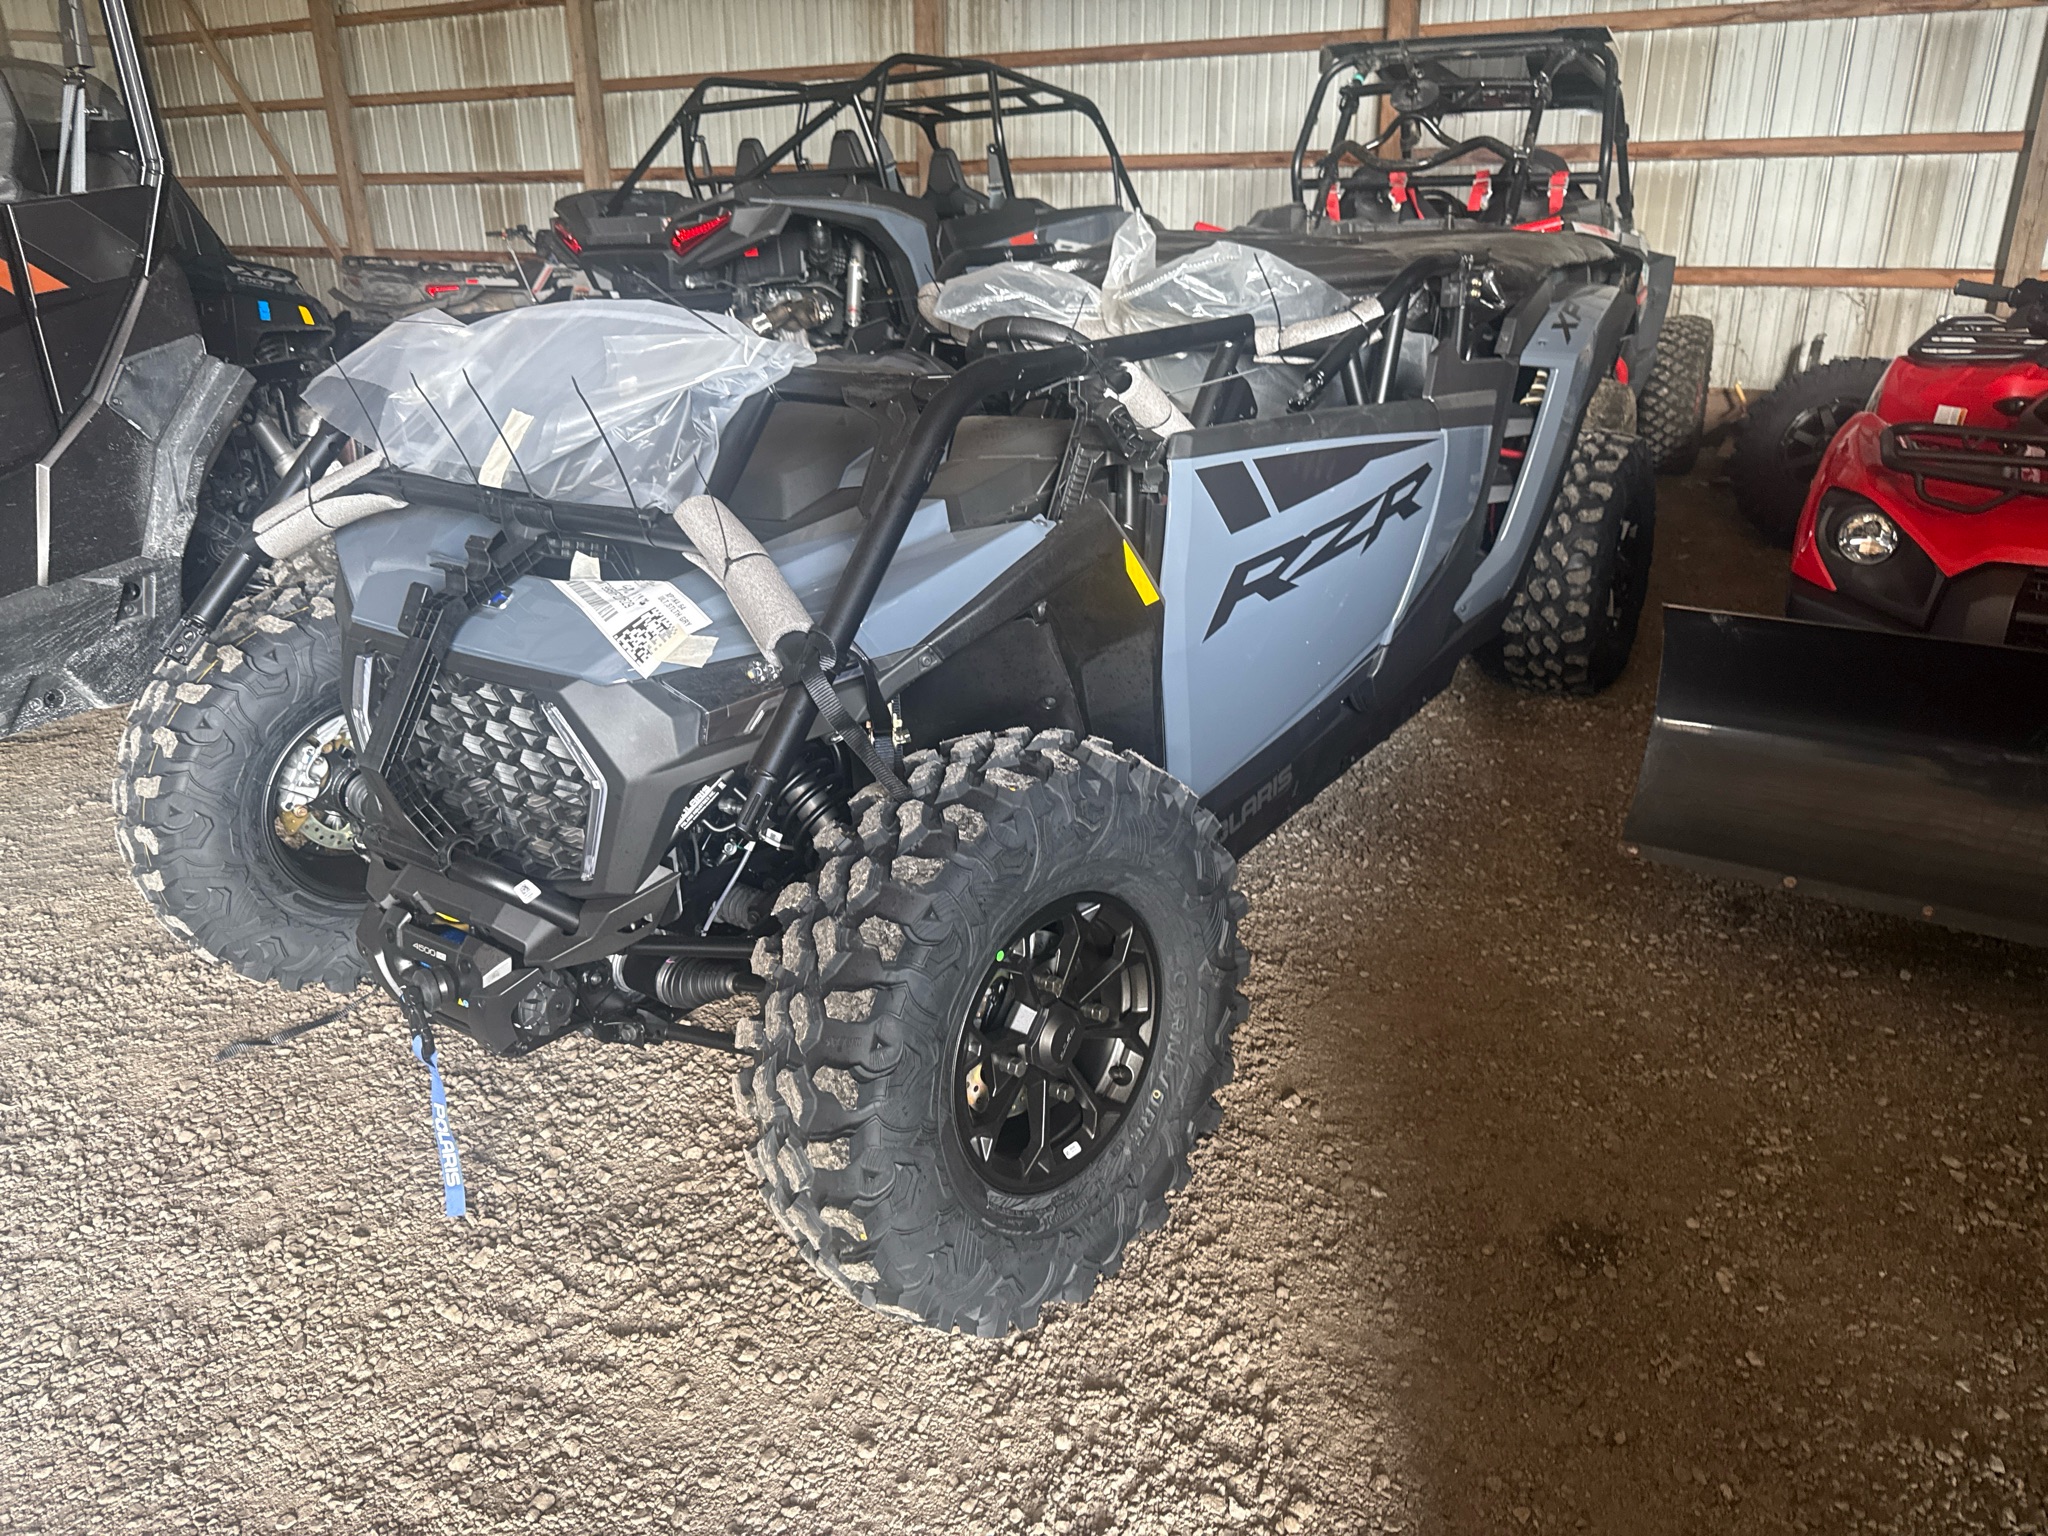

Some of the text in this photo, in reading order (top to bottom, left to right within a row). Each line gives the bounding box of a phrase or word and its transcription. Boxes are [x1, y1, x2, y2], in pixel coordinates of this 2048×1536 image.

[1551, 299, 1582, 345] XP
[1202, 462, 1433, 643] RZR
[412, 942, 436, 957] 4500
[434, 1102, 461, 1187] POLARIS
